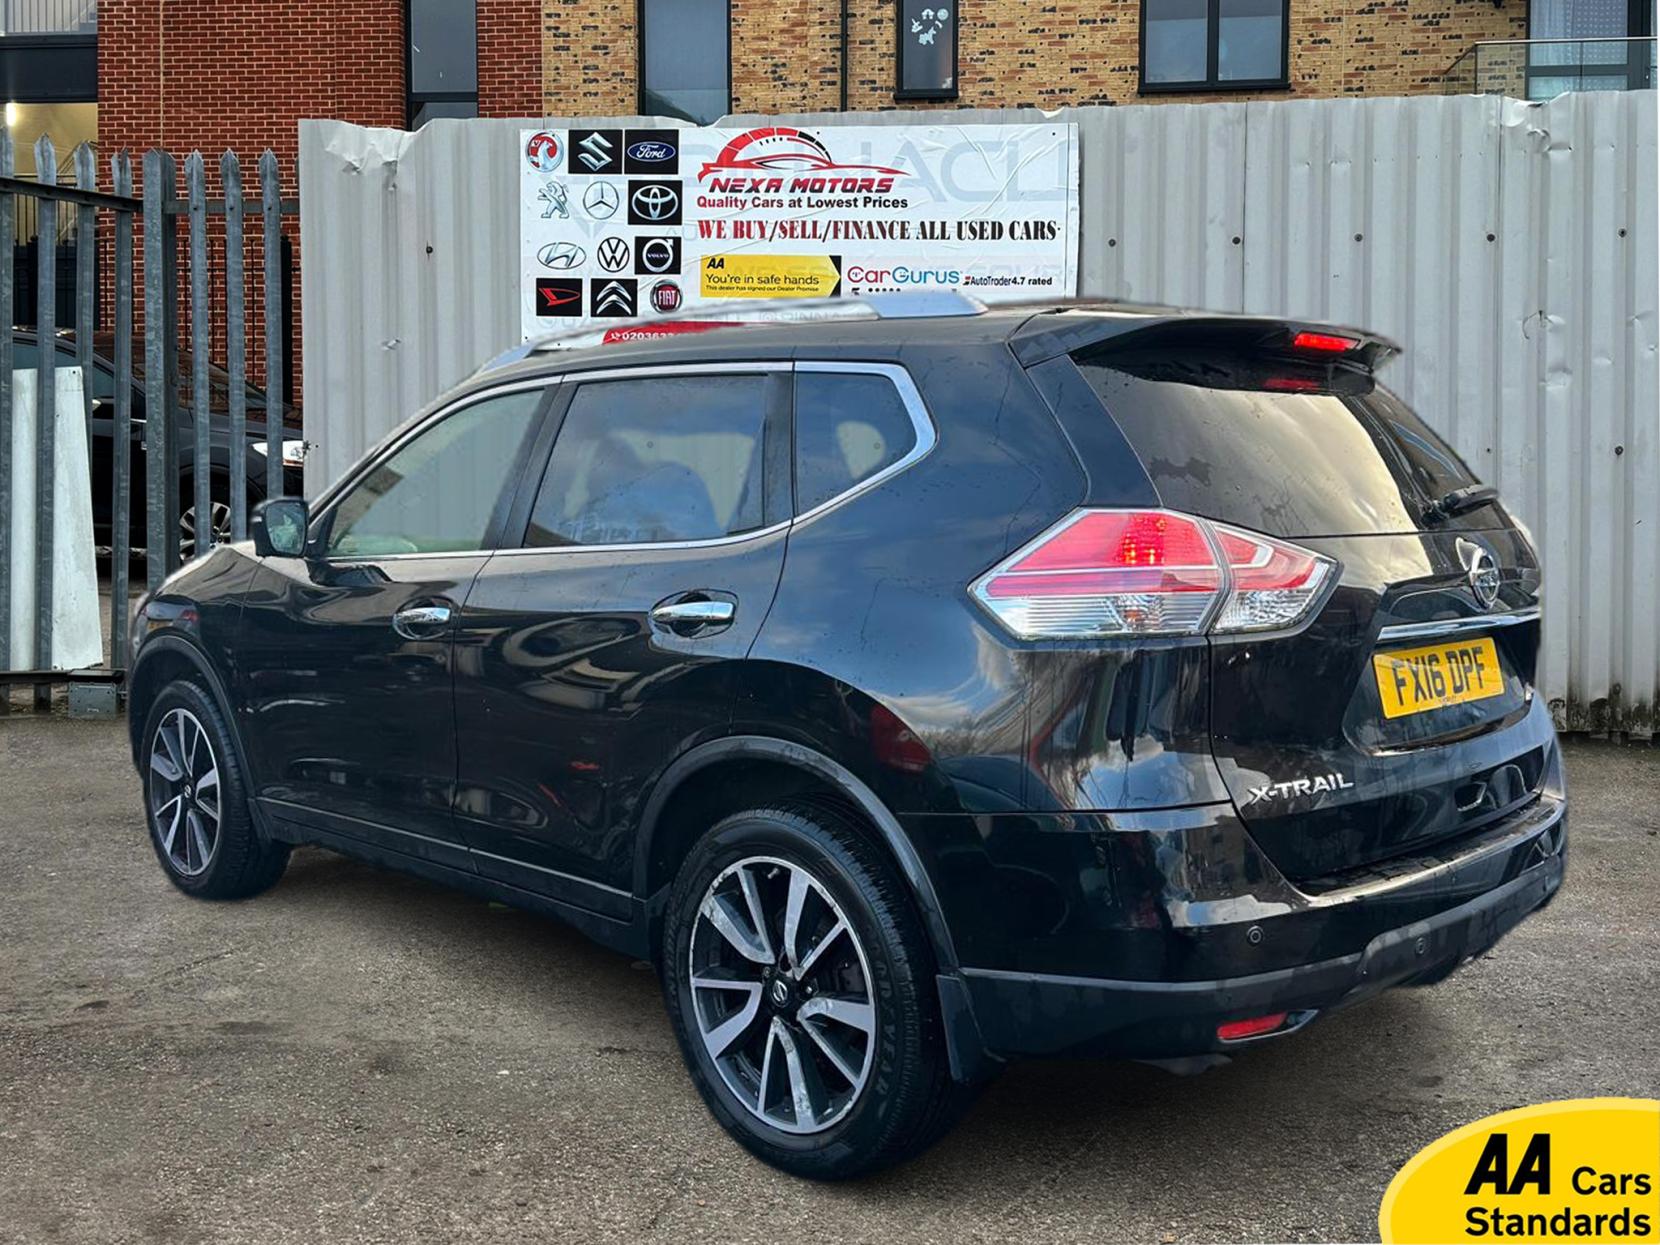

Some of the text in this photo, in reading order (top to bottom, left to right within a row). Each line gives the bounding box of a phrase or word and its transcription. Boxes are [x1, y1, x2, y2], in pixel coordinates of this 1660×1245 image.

[636, 145, 666, 158] Ford
[709, 178, 895, 193] NEXA MOTORS
[697, 196, 908, 210] Quality Cars at Lowest Prices
[697, 219, 727, 240] WE
[915, 220, 951, 240] ALL
[956, 220, 1004, 240] USED
[1008, 220, 1056, 241] CARS
[706, 257, 724, 269] AA
[706, 274, 819, 285] You're in safe hands
[847, 266, 960, 284] CarGurus
[1028, 276, 1053, 286] rated
[658, 290, 676, 305] FIAT
[1392, 646, 1485, 706] FX16 DPF
[1248, 773, 1355, 805] X-TRAIL
